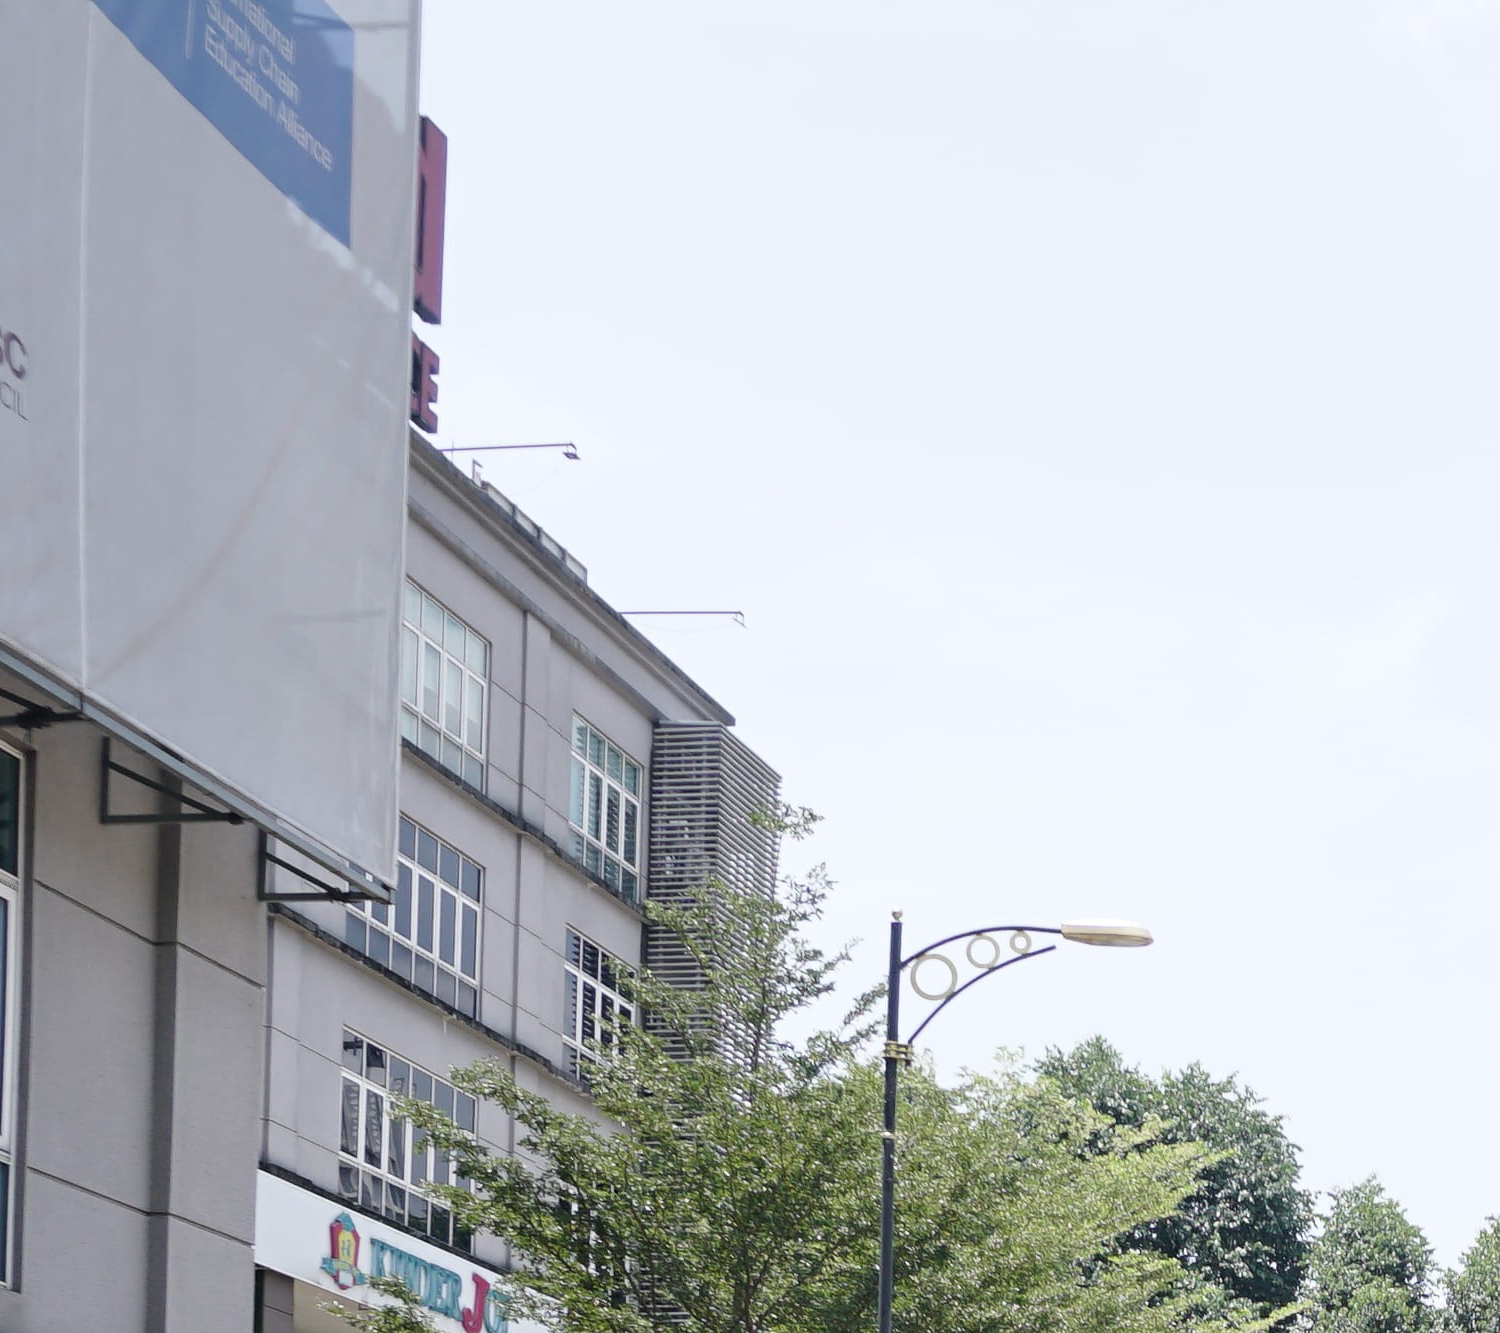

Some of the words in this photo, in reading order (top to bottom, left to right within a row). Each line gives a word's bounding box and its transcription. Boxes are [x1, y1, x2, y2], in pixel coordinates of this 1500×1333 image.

[204, 24, 274, 118] Education
[277, 100, 333, 171] Alliance
[259, 45, 298, 104] Chain
[370, 1238, 462, 1321] KINDER
